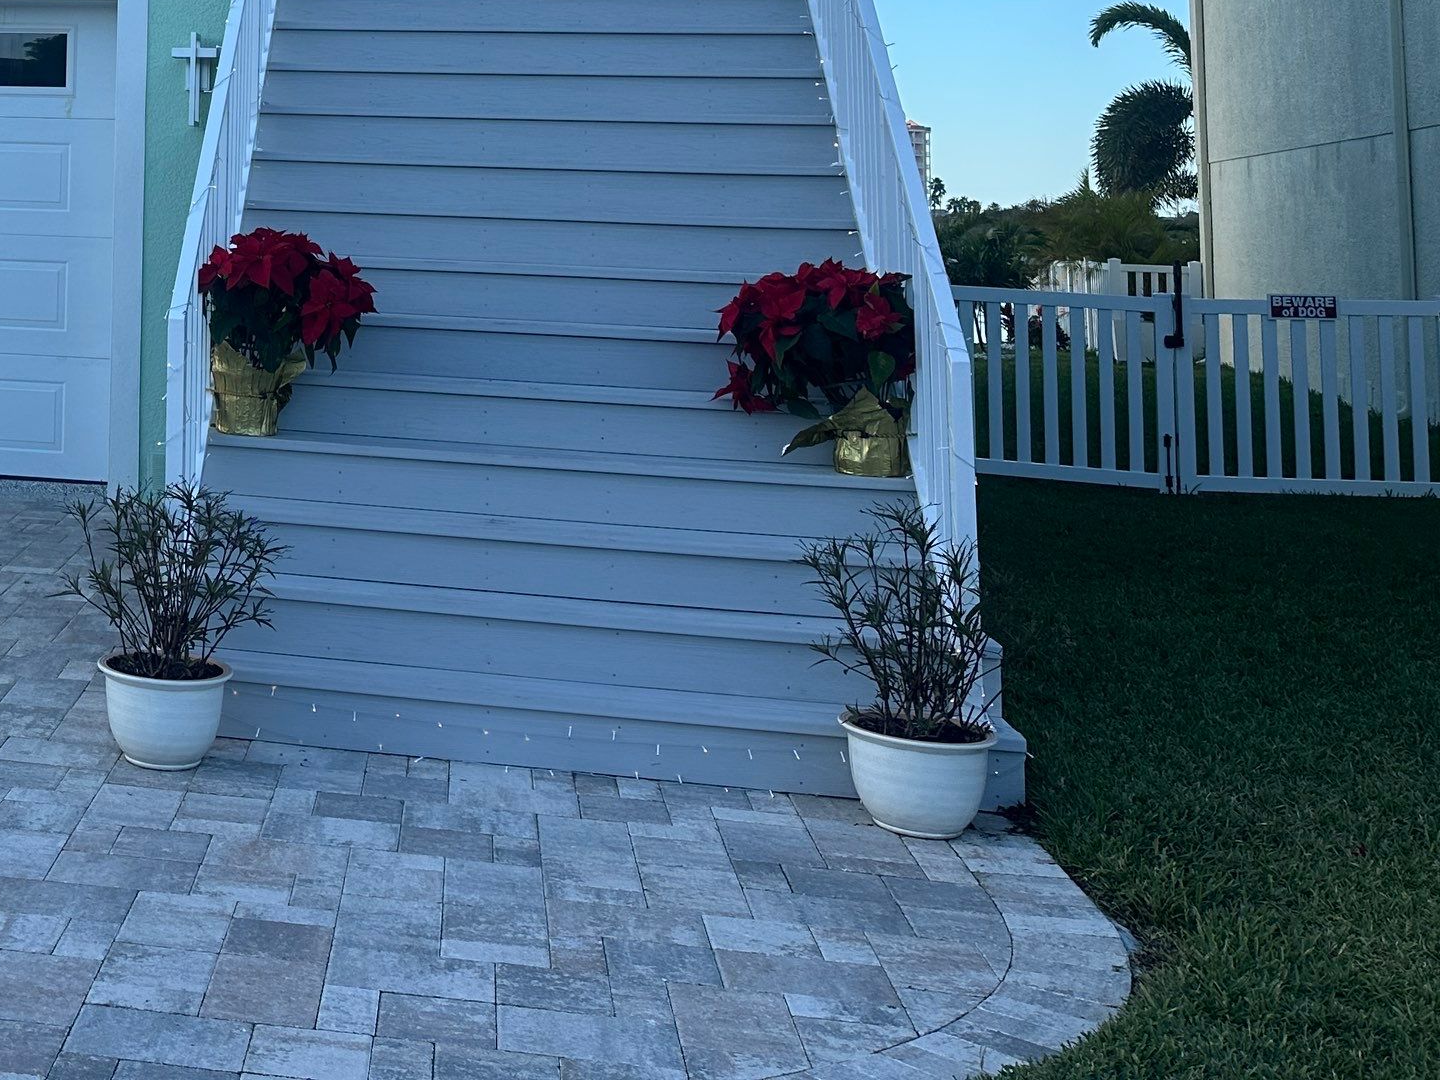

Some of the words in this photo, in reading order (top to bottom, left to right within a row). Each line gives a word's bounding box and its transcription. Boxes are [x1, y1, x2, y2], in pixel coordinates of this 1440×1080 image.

[1272, 296, 1335, 307] BEWARE
[1282, 307, 1294, 317] of
[1298, 307, 1326, 317] DOG
